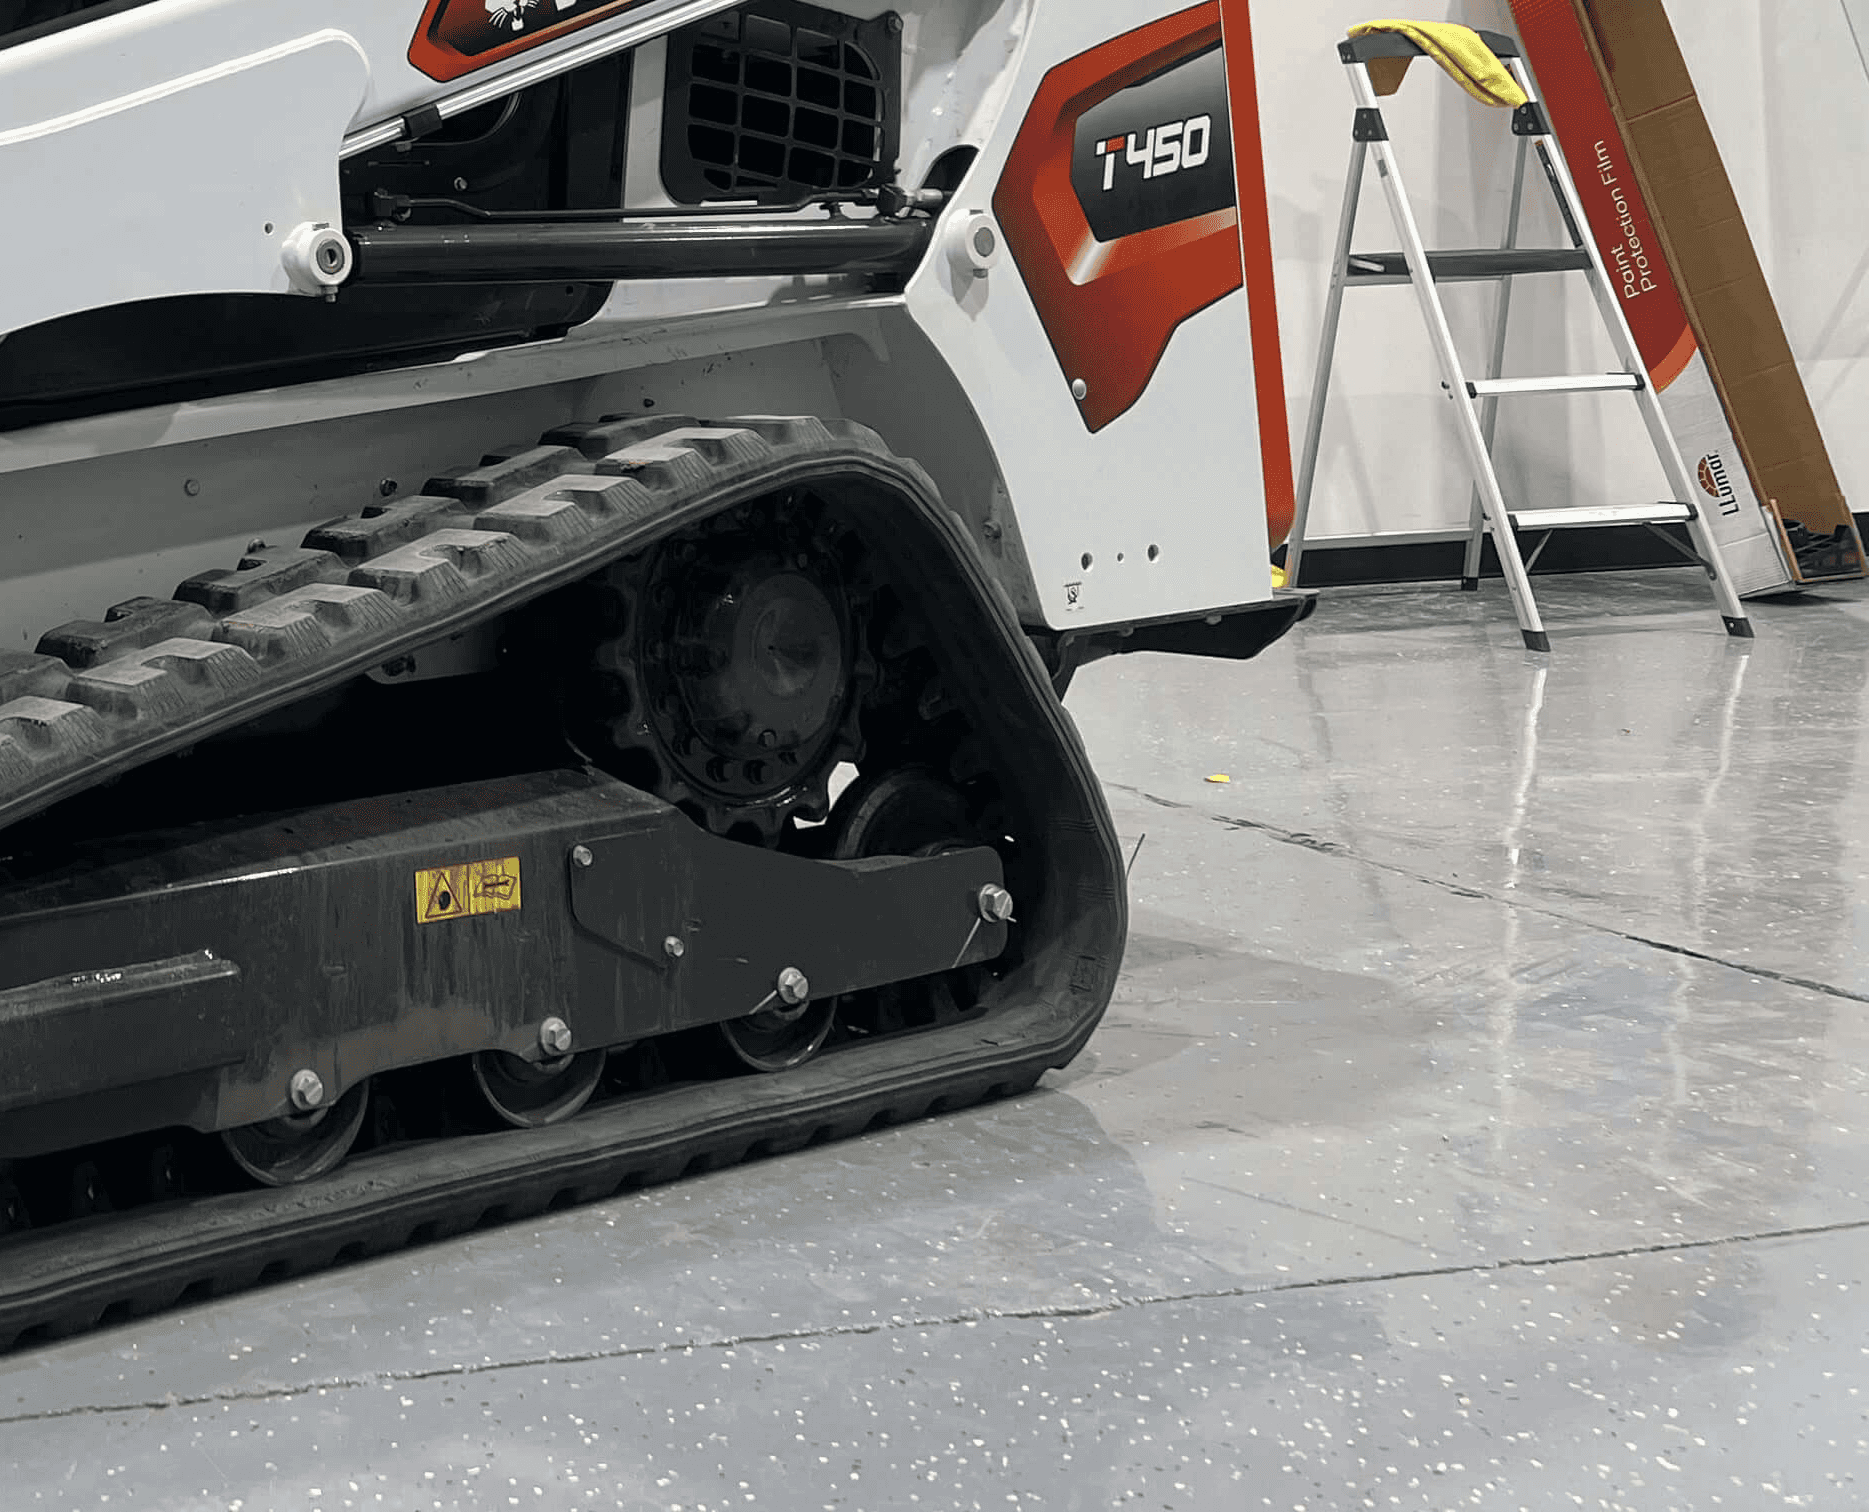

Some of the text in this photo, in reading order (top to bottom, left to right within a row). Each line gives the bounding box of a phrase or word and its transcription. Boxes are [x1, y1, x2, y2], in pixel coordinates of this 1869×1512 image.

[1095, 114, 1212, 191] T450
[1593, 139, 1658, 292] Protection Film
[1610, 243, 1641, 299] Paint
